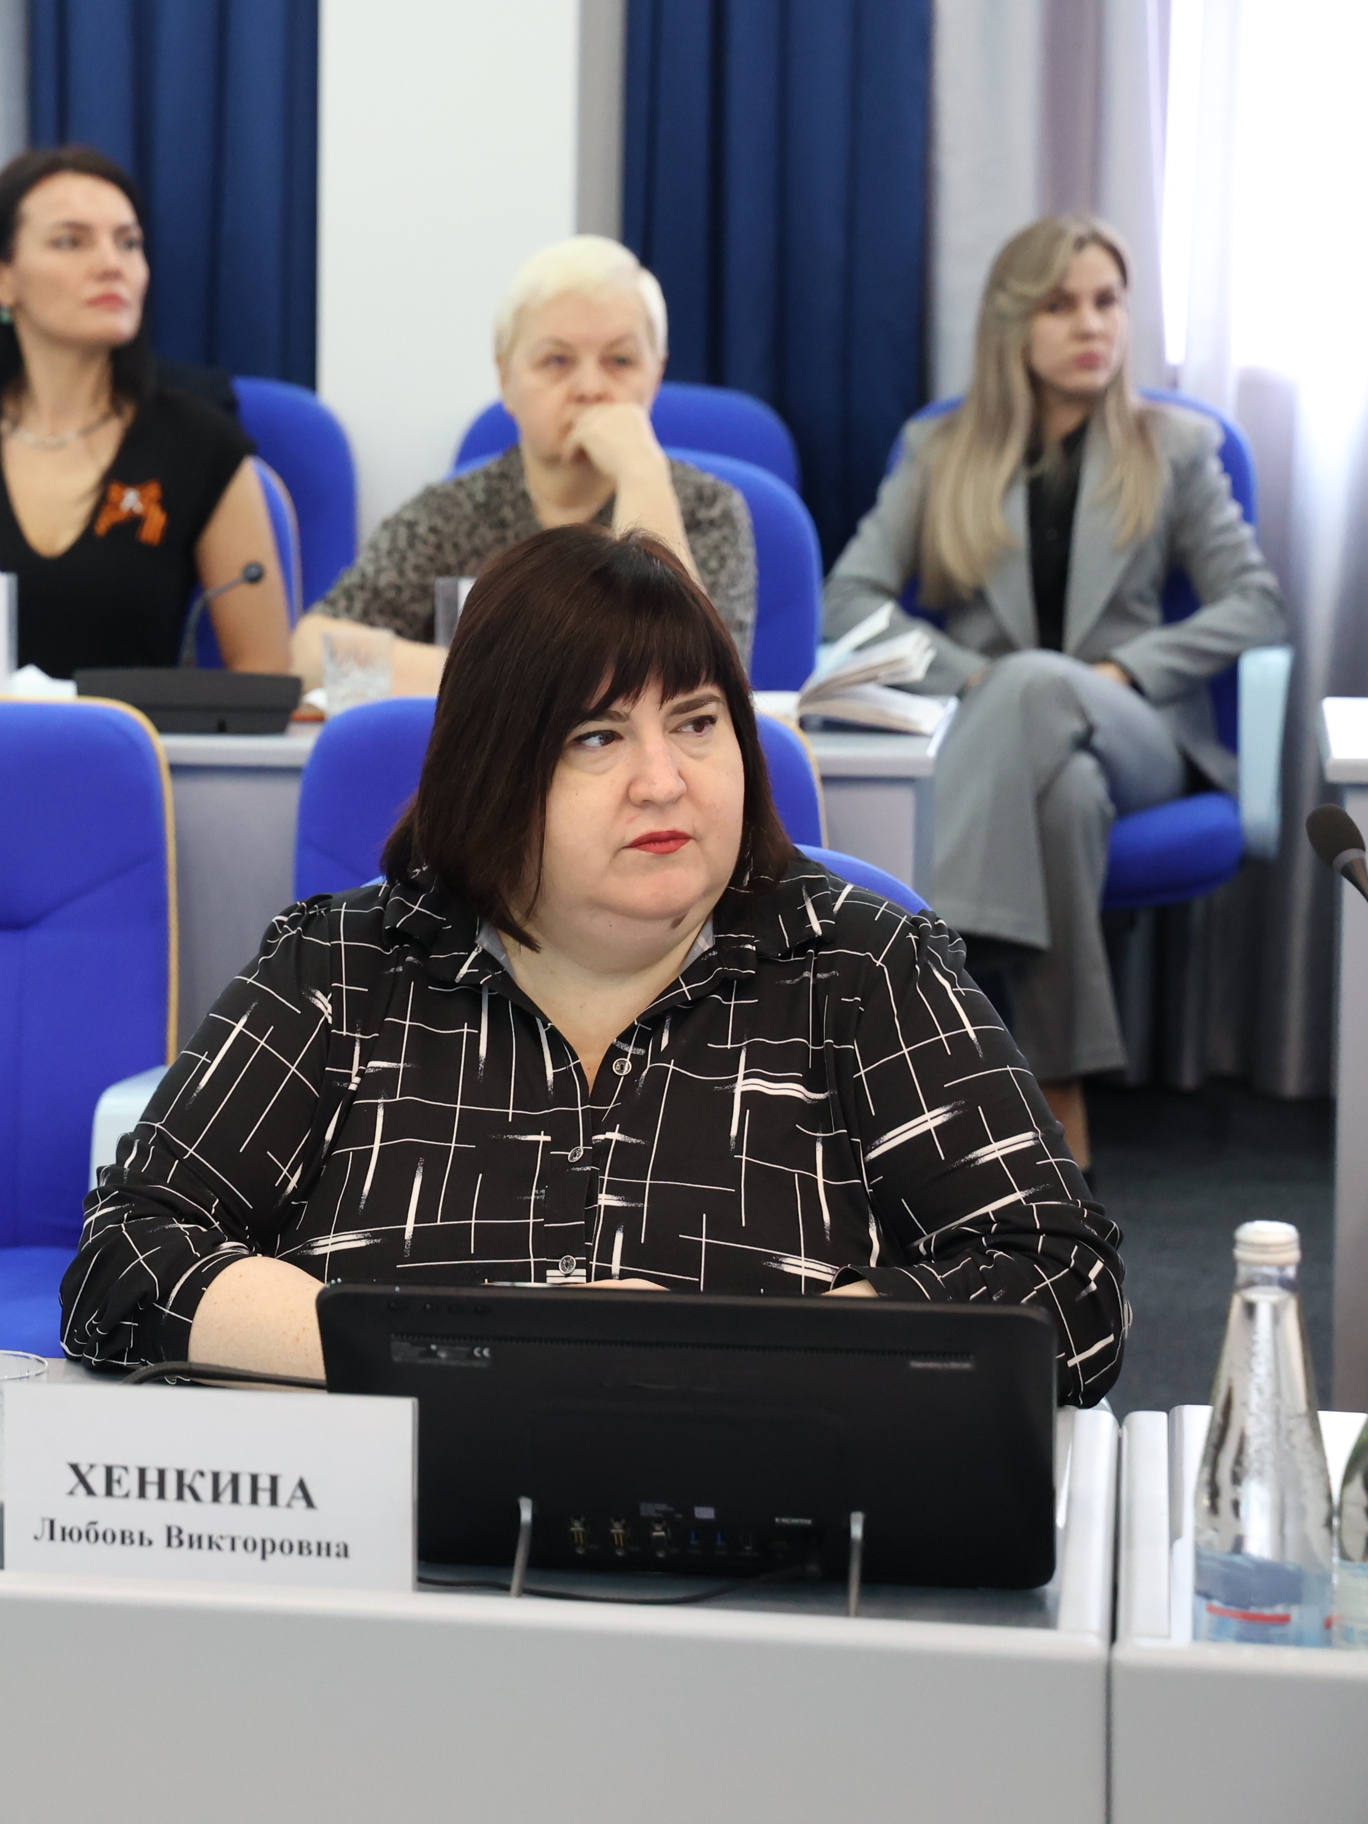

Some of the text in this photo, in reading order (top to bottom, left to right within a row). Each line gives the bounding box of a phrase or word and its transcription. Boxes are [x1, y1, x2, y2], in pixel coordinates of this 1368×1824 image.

[65, 1461, 318, 1510] ХЕНКИНА
[33, 1518, 351, 1562] Любовь Викторовна
